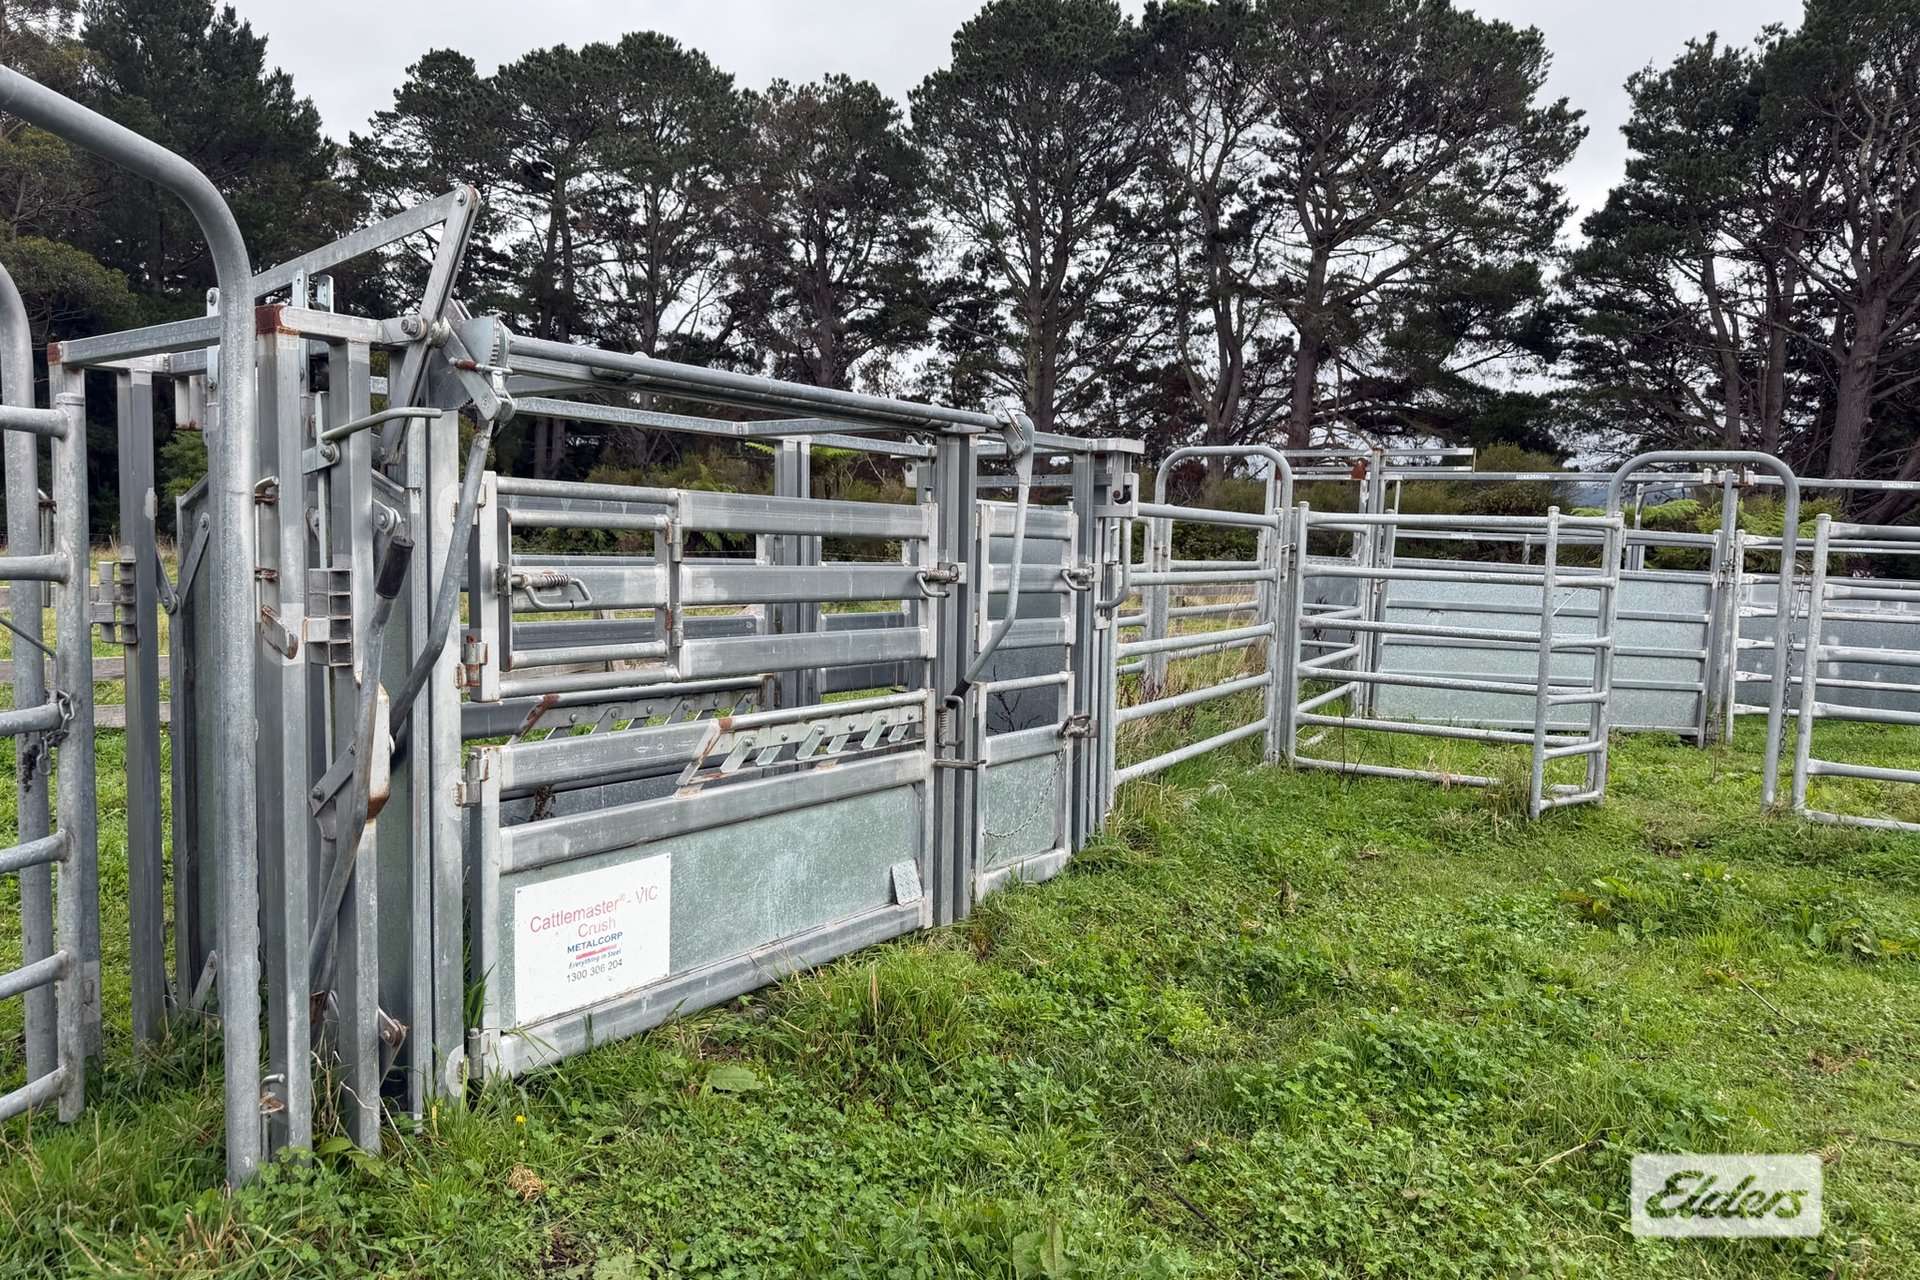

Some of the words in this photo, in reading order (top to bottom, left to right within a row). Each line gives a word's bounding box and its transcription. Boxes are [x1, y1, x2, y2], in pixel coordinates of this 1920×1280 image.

[635, 885, 659, 904] VIC
[577, 916, 616, 938] Crush
[567, 931, 623, 954] METALCORP
[567, 969, 588, 984] 1300
[590, 963, 606, 977] 306
[608, 958, 623, 971] 204
